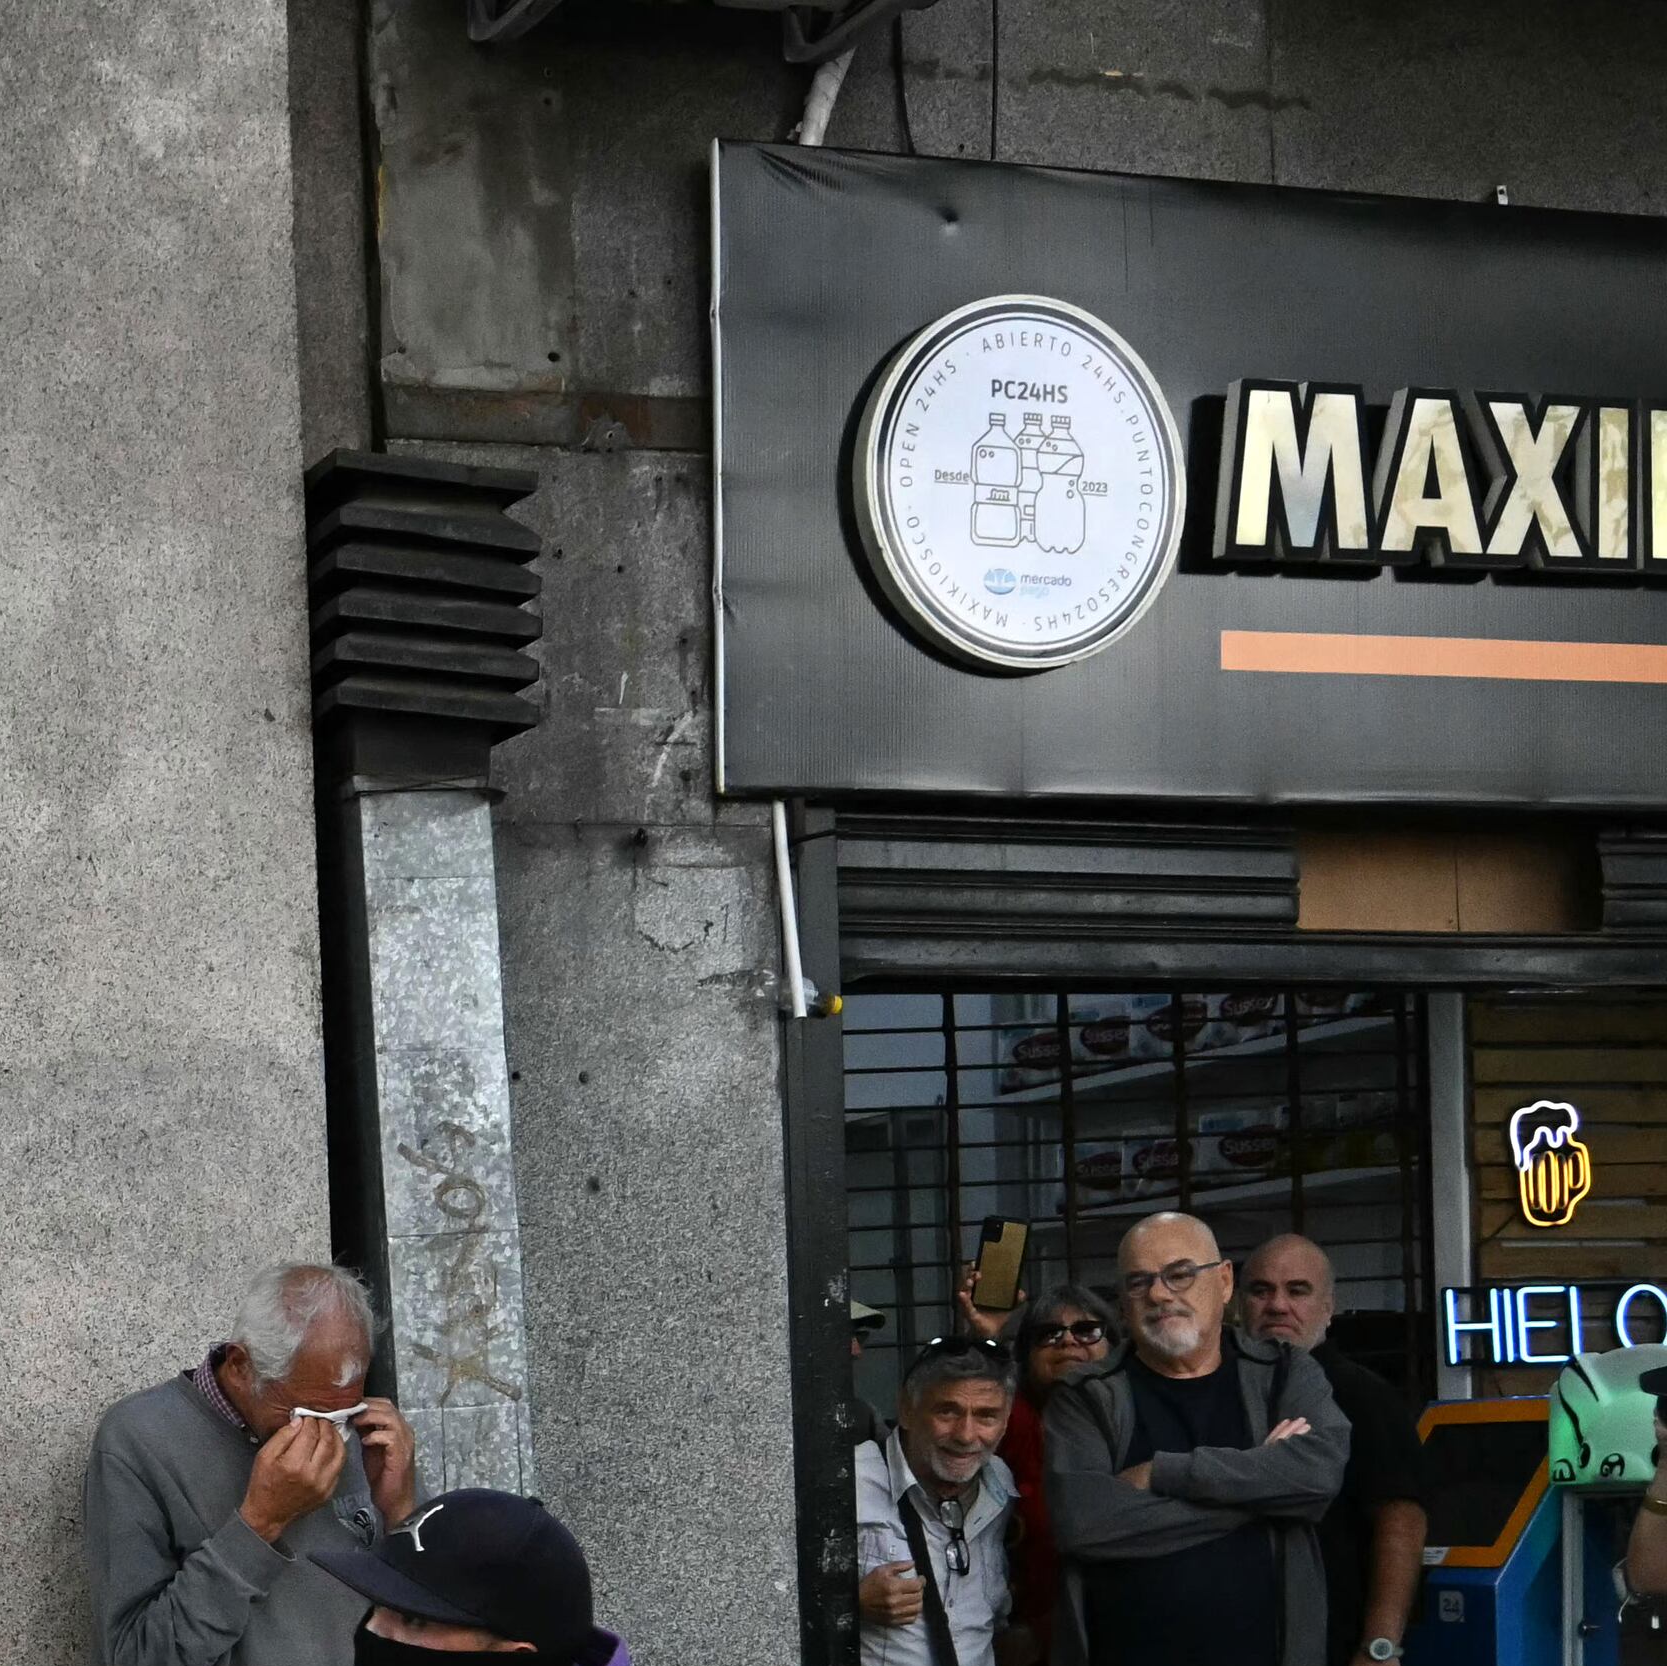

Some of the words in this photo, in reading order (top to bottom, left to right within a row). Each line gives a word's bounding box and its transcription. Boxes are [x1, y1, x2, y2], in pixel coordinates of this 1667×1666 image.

[982, 331, 1072, 358] ABIERTO
[990, 379, 1069, 404] PC24HS
[899, 422, 921, 489] OPEN
[915, 358, 957, 412] 24HS
[934, 468, 970, 482] Desde
[1229, 380, 1667, 565] MAXI
[1081, 481, 1108, 494] 2023
[1020, 574, 1072, 587] mercado
